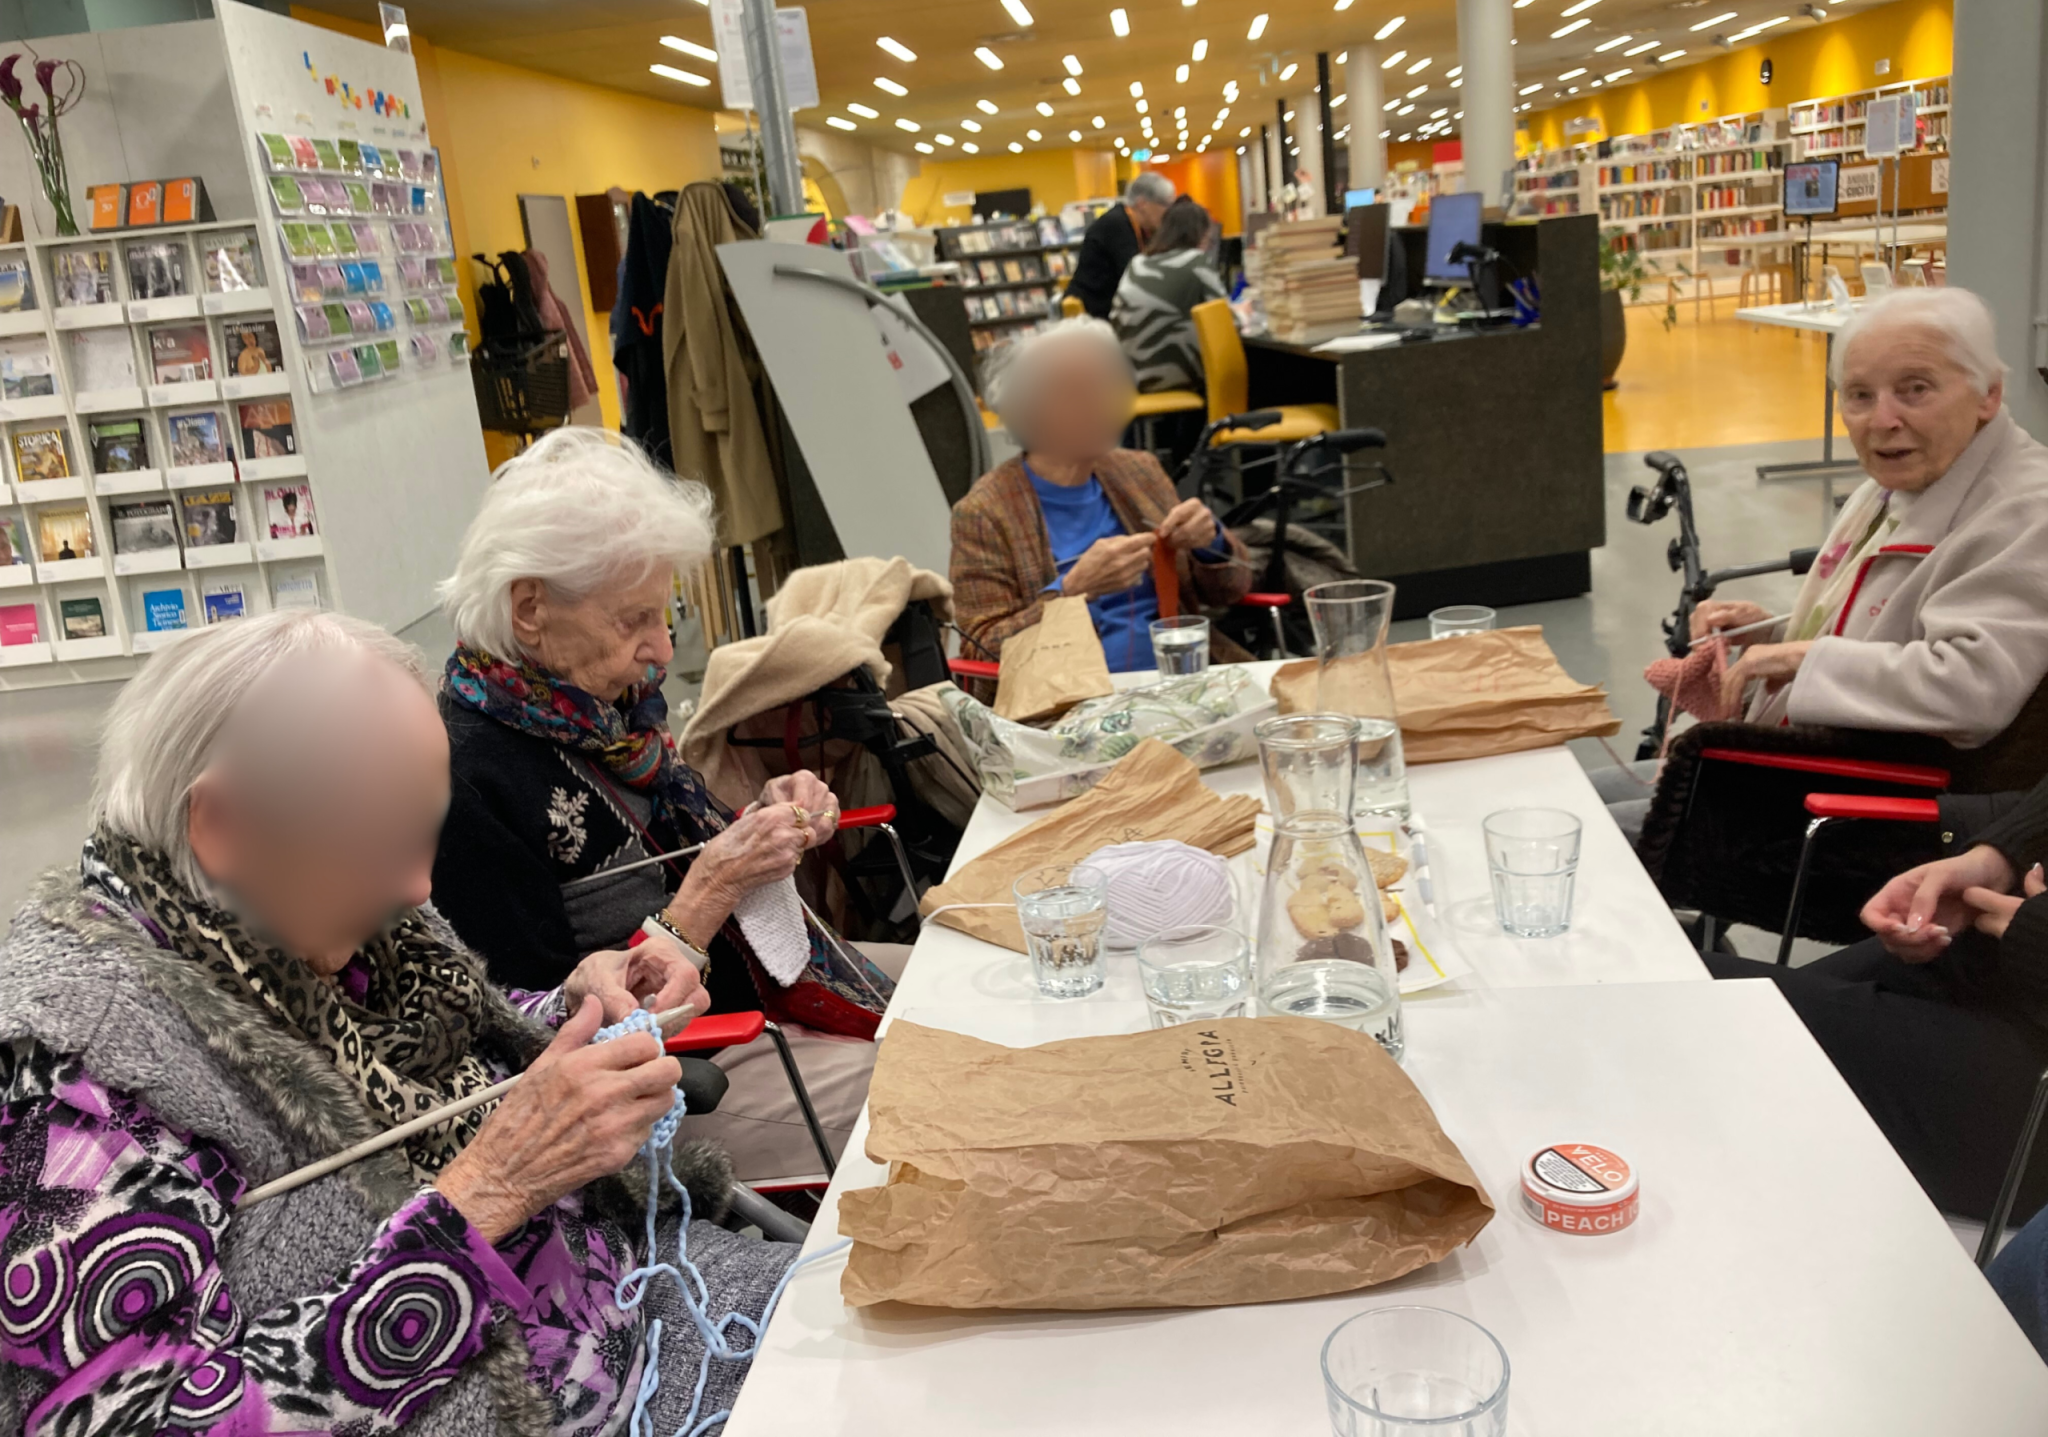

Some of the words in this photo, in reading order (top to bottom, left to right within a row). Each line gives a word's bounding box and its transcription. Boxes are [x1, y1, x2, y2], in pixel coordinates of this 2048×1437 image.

[151, 602, 179, 612] Archivio
[153, 611, 177, 619] Storico
[1571, 1145, 1623, 1182] VELO
[1547, 1209, 1624, 1231] PEACH
